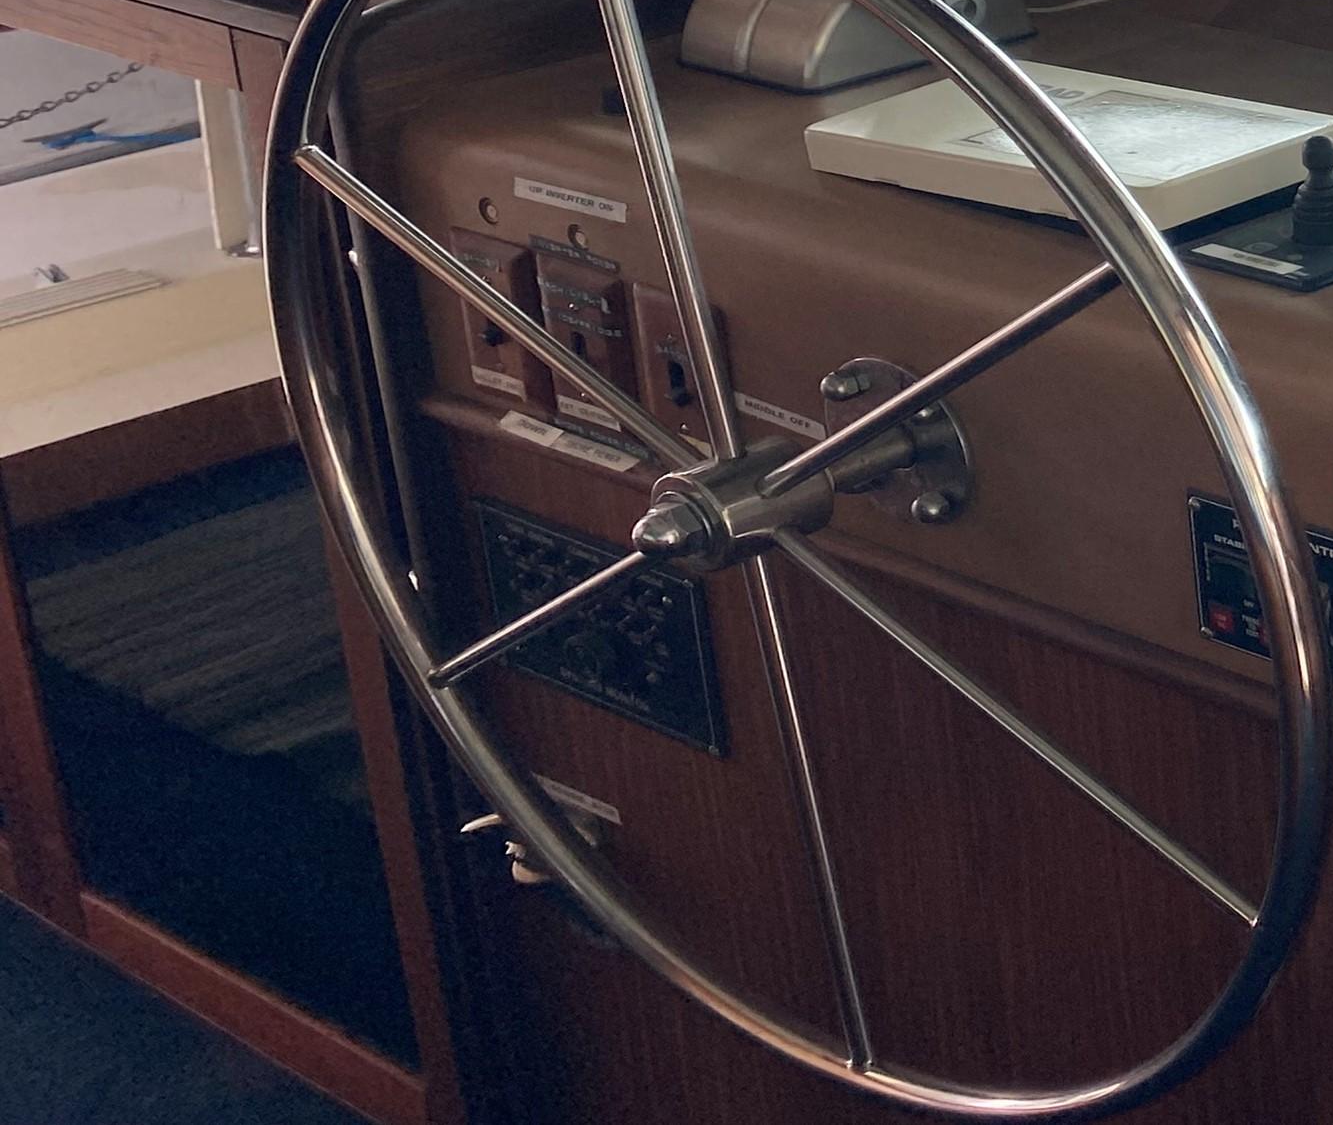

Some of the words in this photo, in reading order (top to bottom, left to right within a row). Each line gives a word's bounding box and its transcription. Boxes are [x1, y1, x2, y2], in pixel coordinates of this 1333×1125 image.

[546, 190, 594, 207] INVERTER
[744, 400, 785, 420] MIDDLE
[789, 416, 811, 429] OFF
